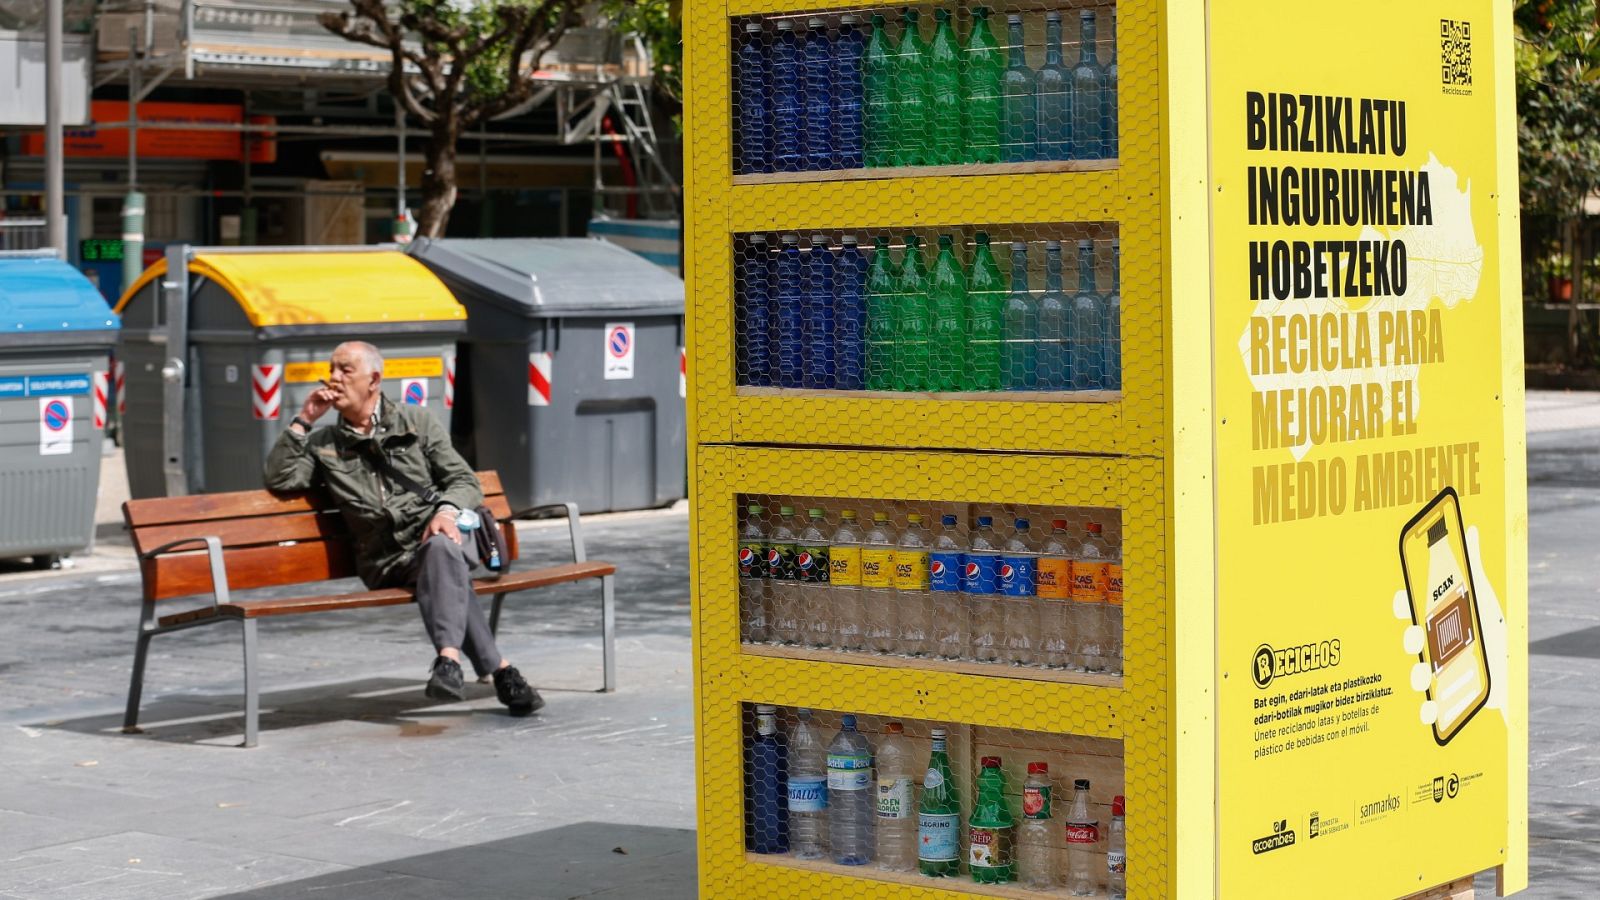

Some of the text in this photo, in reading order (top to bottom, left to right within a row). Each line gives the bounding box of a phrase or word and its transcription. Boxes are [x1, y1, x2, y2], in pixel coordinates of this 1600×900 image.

[1246, 91, 1407, 156] BIRZIKLATU
[1247, 166, 1433, 226] INGURUMENA
[1249, 239, 1408, 300] HOBETZEKO
[1250, 309, 1445, 376] RECICLA PARA
[1251, 380, 1417, 450] MEJORAR EL
[1252, 442, 1481, 526] MEDIO AMBIENTE
[1075, 574, 1093, 584] KAS
[1432, 575, 1454, 601] SCAN
[1253, 639, 1340, 688] RECICLOS
[1254, 673, 1382, 709] Bat egin, edari-latak eta plastikozko
[1254, 687, 1393, 725] edari-botilak mugikor bidez birziklatuz.
[1254, 704, 1379, 741] Únete reciclando latas y botellas de
[1254, 722, 1370, 760] plástico de bebidas con el móvil.
[1360, 794, 1400, 818] sanmarkos
[1253, 832, 1294, 852] ecoembes
